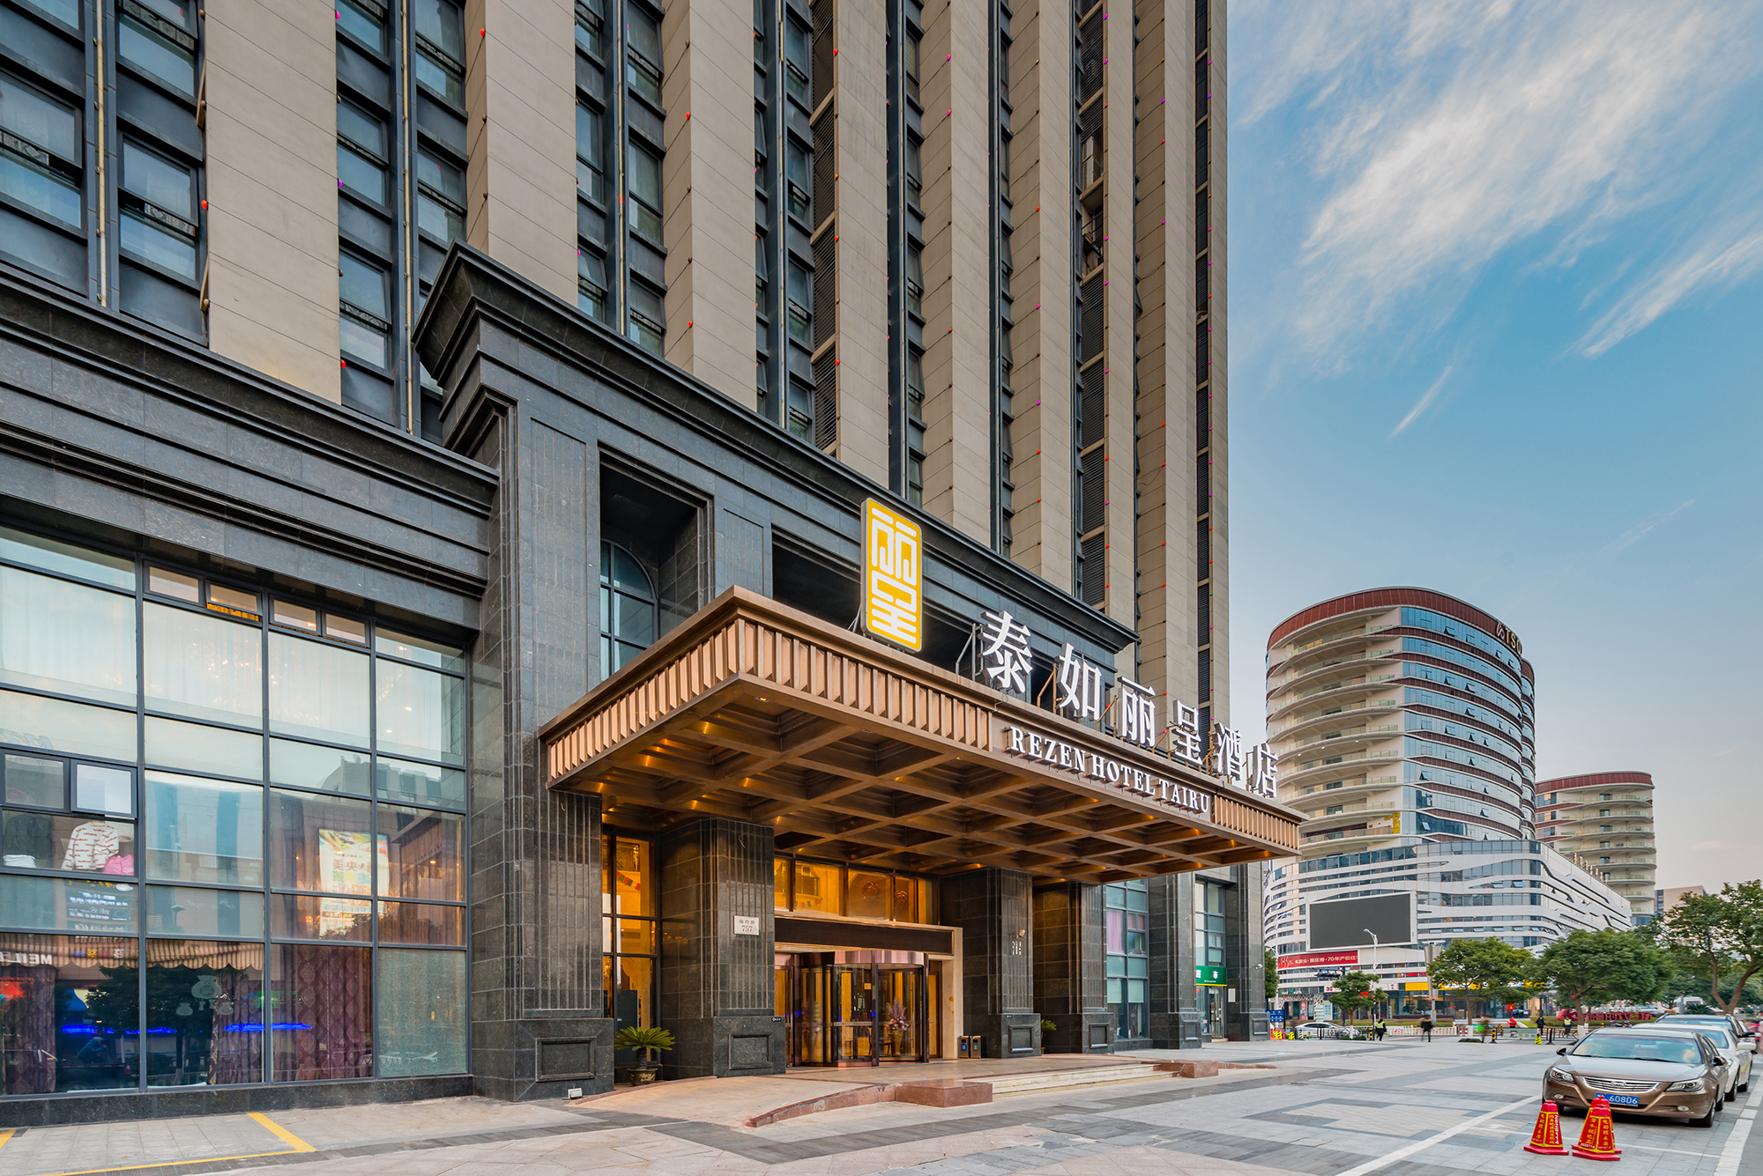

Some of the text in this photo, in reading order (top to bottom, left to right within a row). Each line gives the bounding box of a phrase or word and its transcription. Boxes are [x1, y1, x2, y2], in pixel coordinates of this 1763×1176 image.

[982, 610, 1278, 799] 泰如丽呈酒店
[1010, 726, 1211, 813] REZEN HOTEL TAIRU
